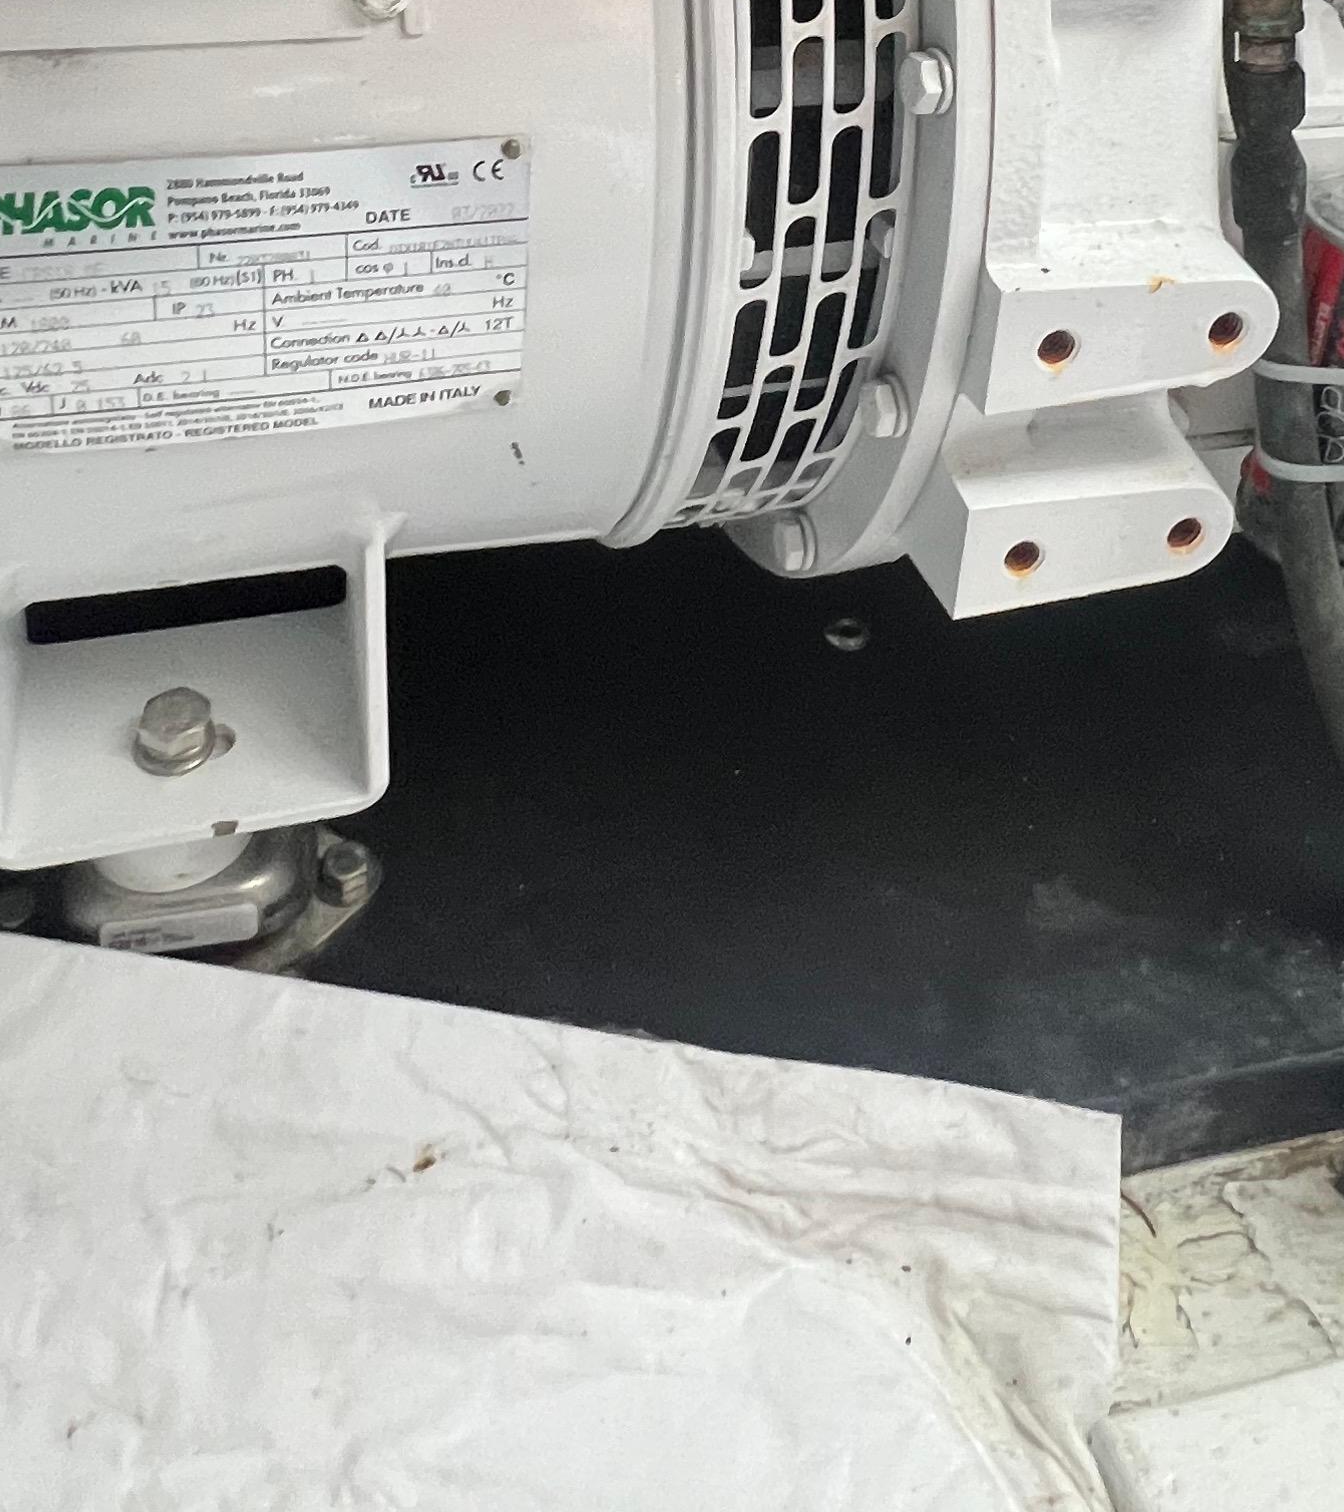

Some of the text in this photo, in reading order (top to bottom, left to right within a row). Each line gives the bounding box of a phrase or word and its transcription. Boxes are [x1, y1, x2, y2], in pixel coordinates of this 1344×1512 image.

[365, 208, 412, 225] DATE
[43, 231, 157, 248] MARINE
[355, 262, 379, 274] cos
[110, 279, 143, 294] kVA
[272, 289, 332, 305] Ambient
[337, 283, 424, 303] Temperature
[271, 295, 514, 328] V Hz
[233, 318, 256, 332] Hz
[270, 316, 514, 349] Connection 12T
[271, 353, 339, 372] Regulator
[343, 348, 378, 363] code
[368, 385, 481, 409] MADE IN ITALY
[86, 430, 174, 447] REGISTRATO
[184, 421, 270, 437] REGISTERED
[273, 416, 319, 430] MODEL
